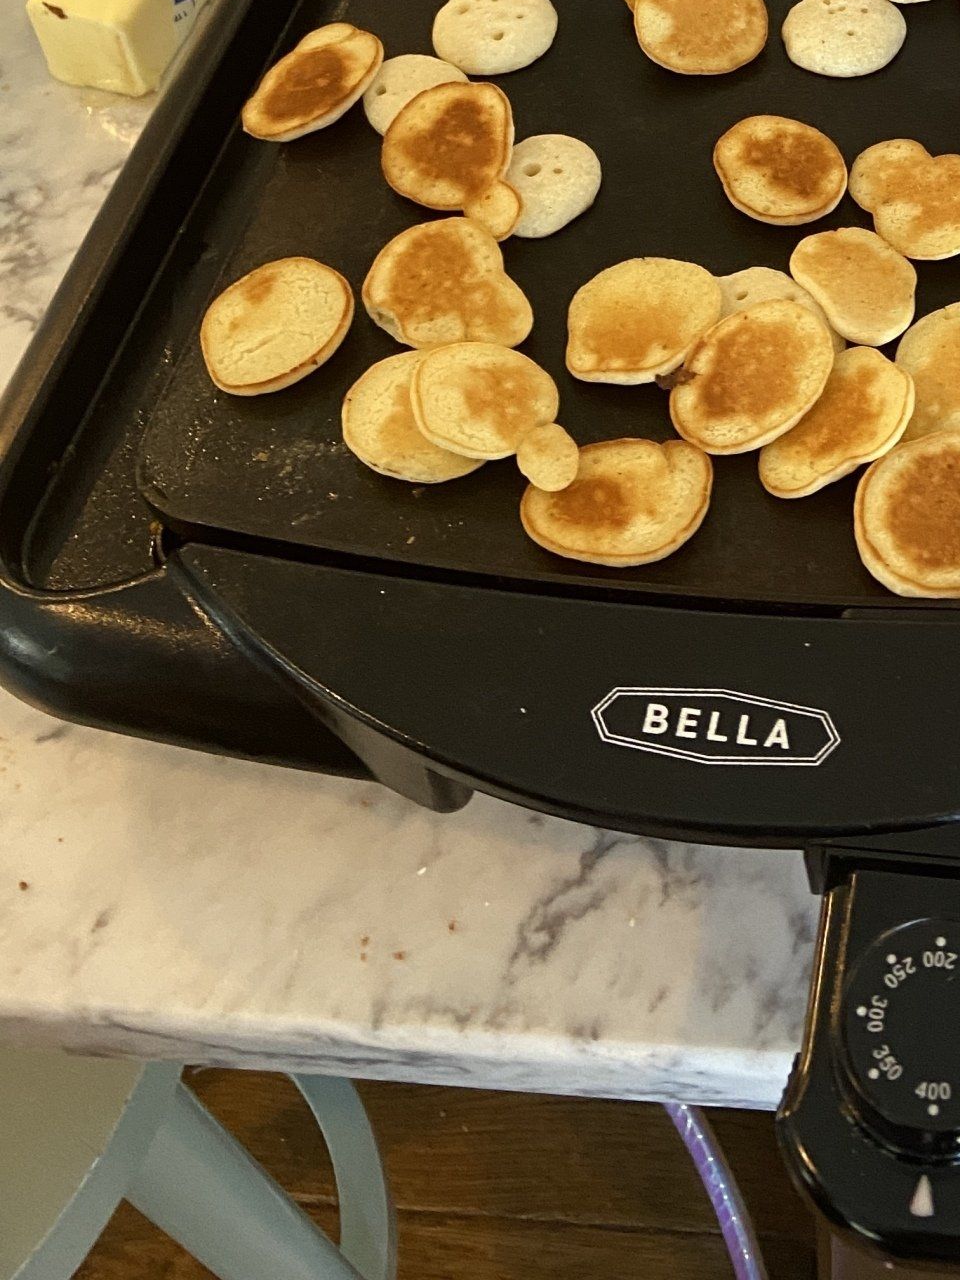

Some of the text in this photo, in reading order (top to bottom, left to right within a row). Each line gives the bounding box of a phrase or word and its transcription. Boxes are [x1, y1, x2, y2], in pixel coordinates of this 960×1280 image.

[642, 703, 790, 750] BELLA
[884, 956, 917, 989] 250
[922, 950, 958, 970] 200
[866, 994, 888, 1033] 300
[872, 1044, 903, 1080] 350
[915, 1081, 951, 1100] 400
